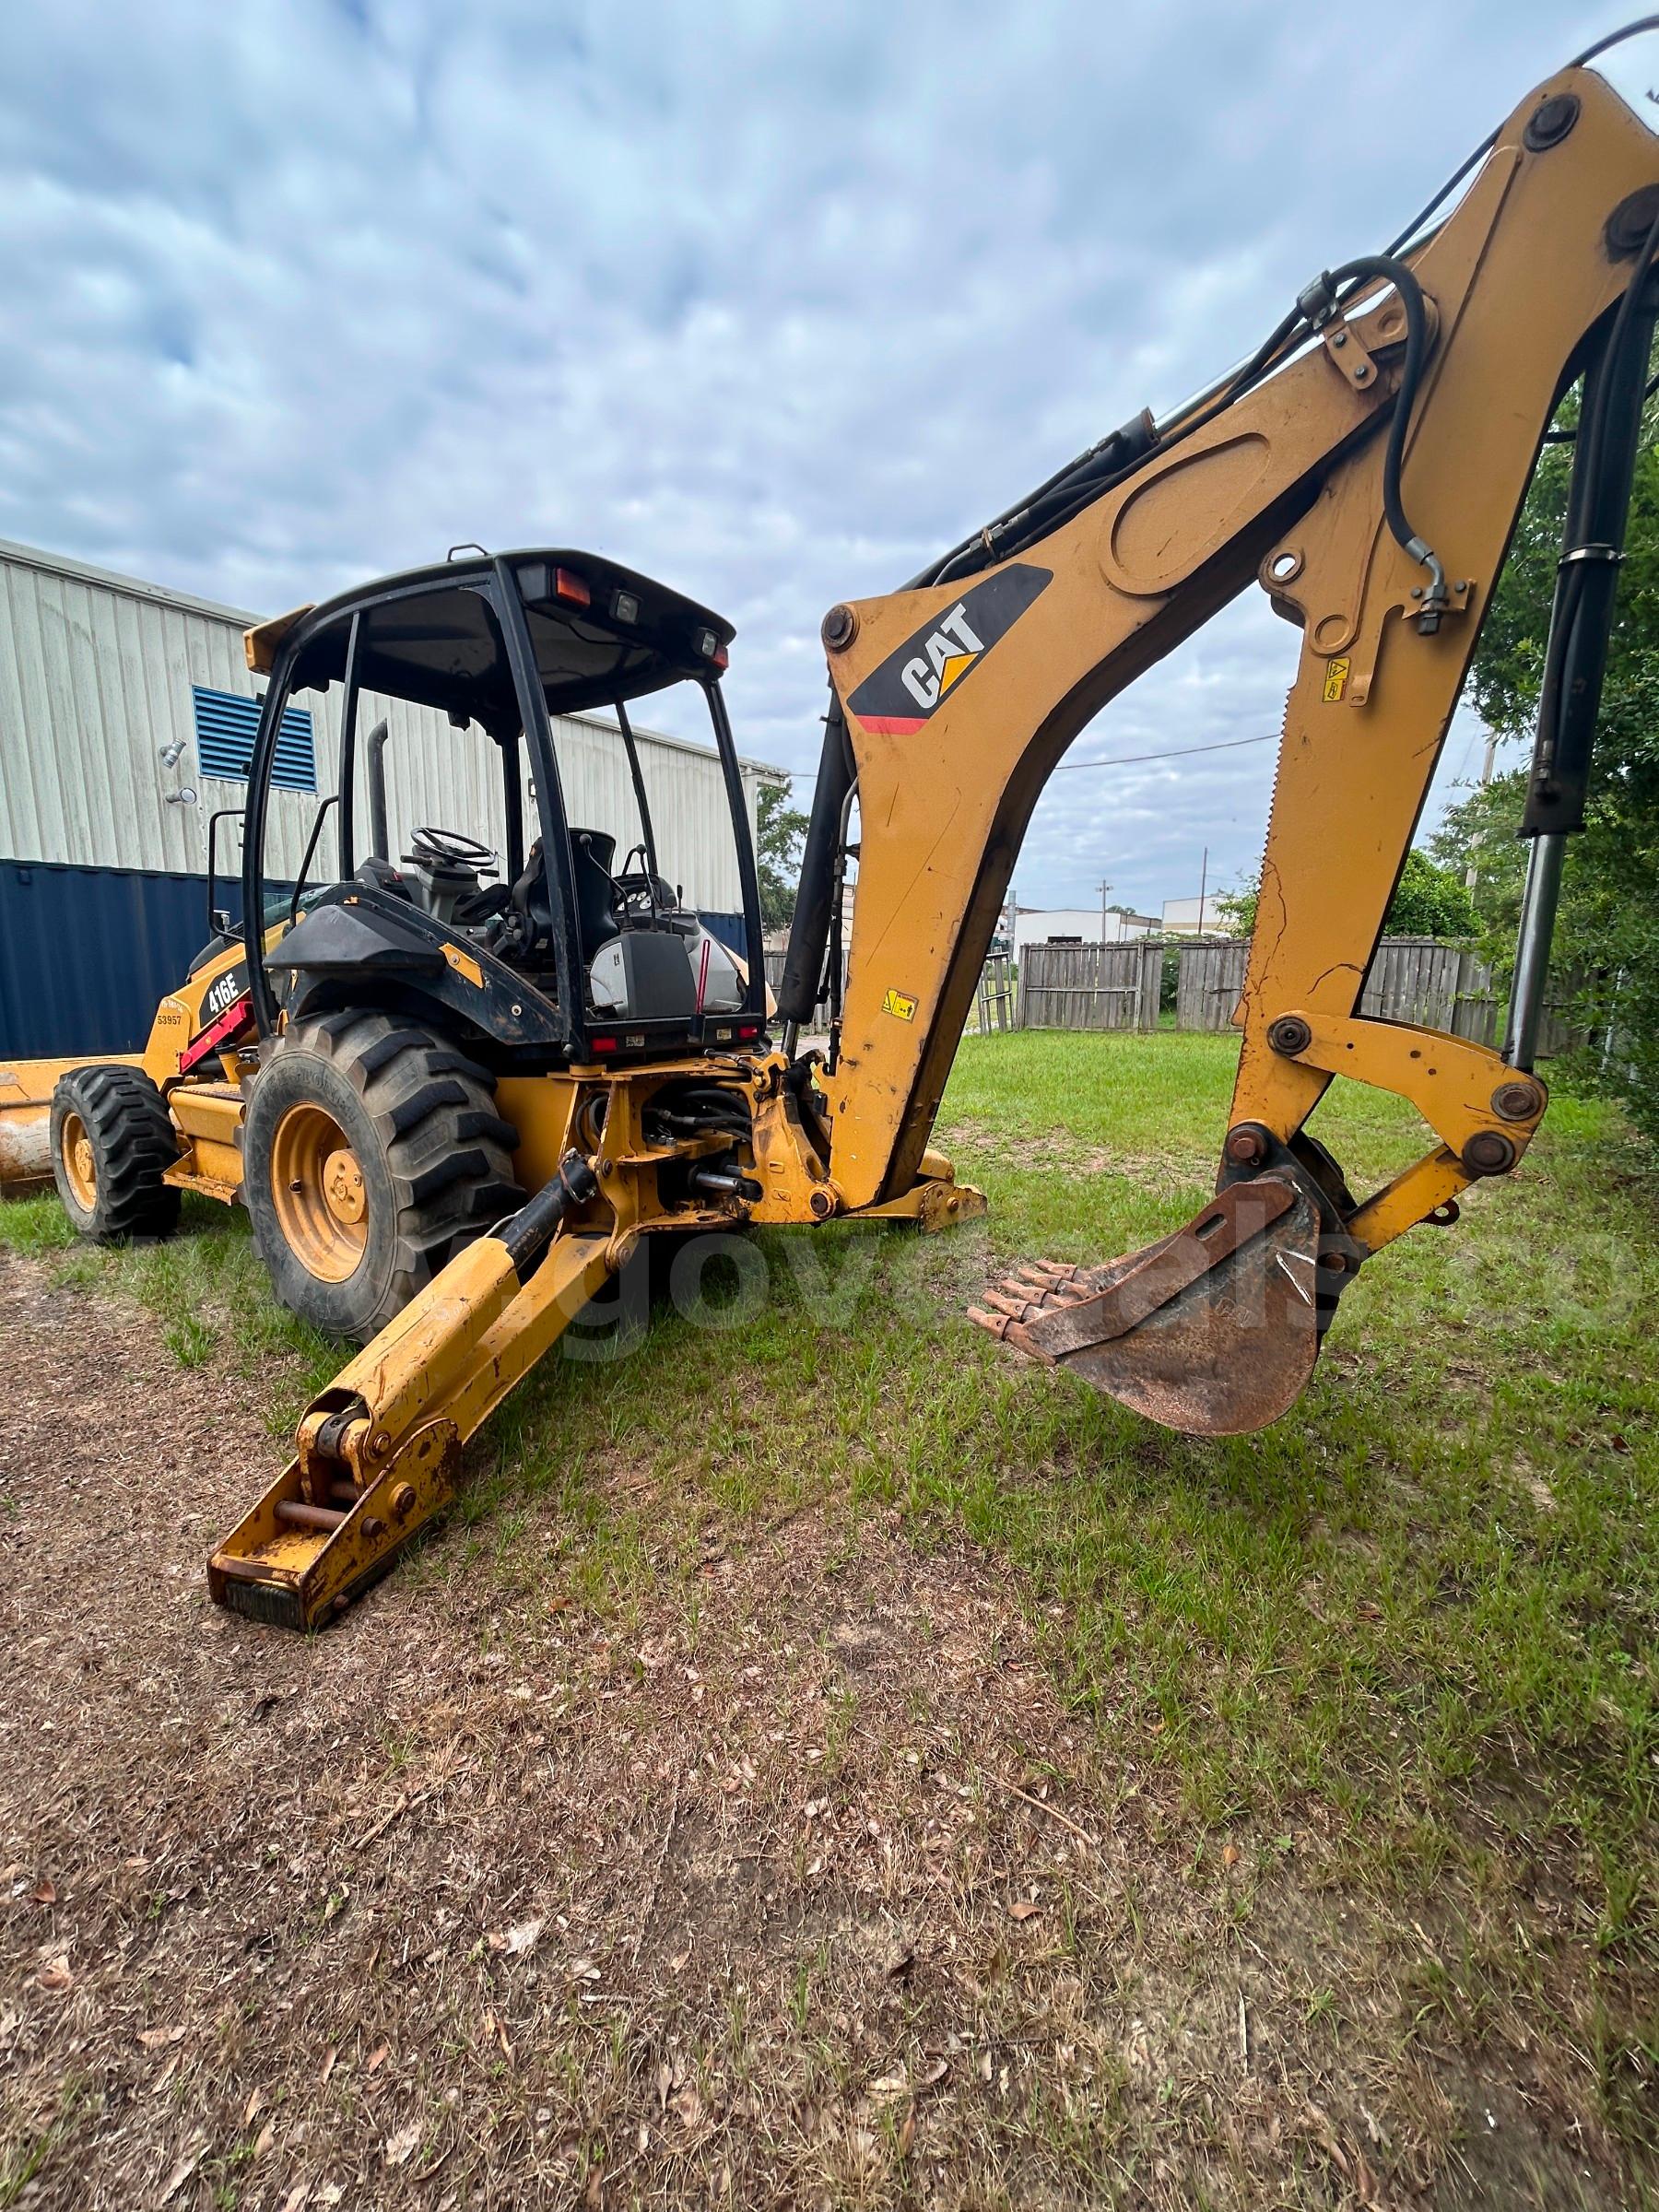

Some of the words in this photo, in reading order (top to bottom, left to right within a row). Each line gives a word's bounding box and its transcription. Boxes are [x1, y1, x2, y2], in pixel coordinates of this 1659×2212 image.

[901, 602, 985, 709] CAT
[208, 972, 240, 1014] 416E
[157, 1015, 182, 1026] 53957
